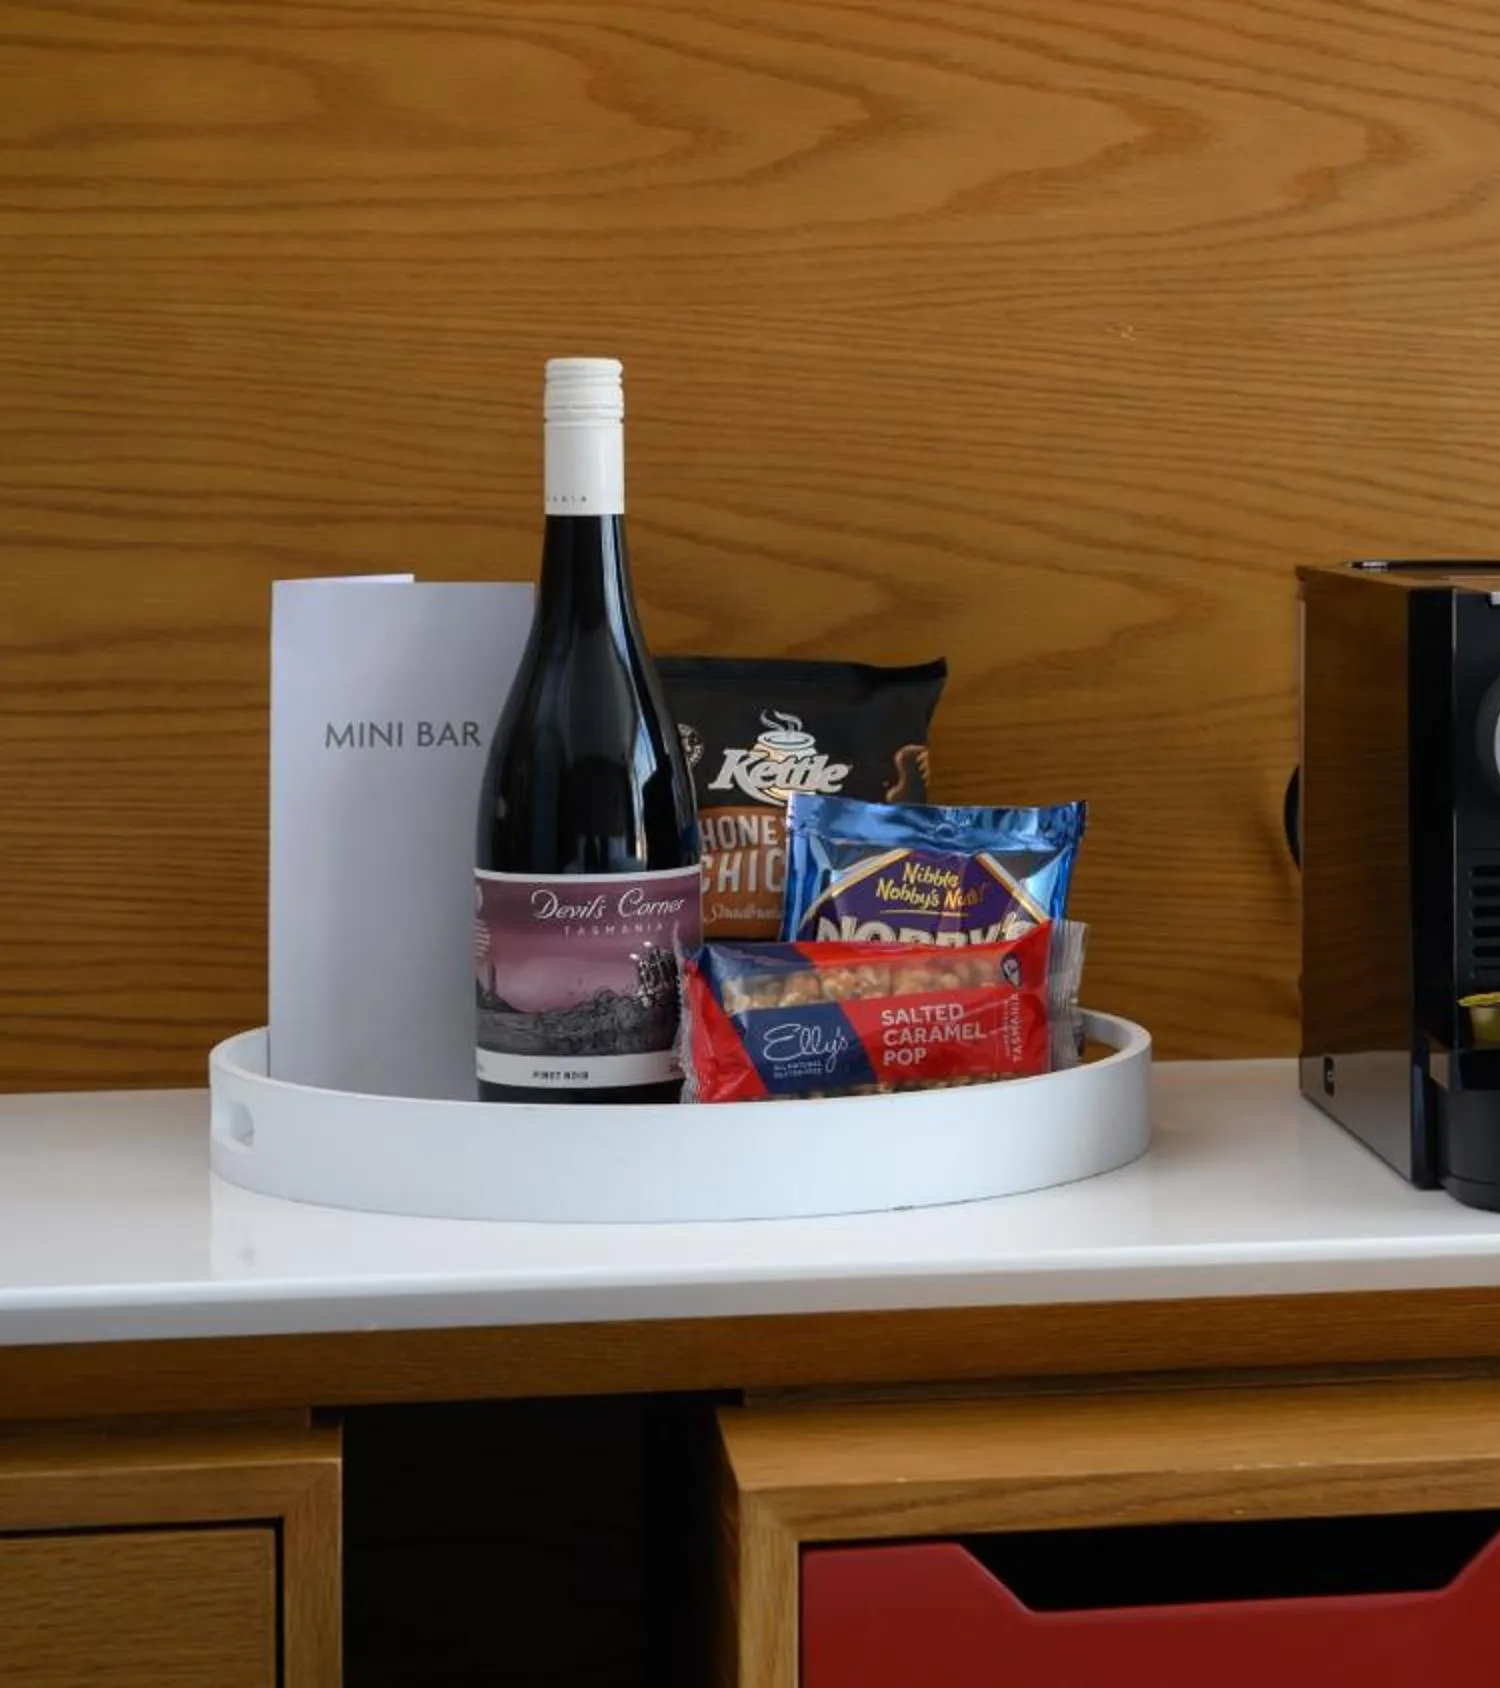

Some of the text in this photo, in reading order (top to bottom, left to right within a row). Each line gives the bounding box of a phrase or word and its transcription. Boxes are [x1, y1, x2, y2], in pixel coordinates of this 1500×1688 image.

[325, 721, 481, 749] MINI BAR
[708, 749, 852, 807] Kettle
[902, 862, 959, 886] Nibble
[531, 889, 607, 919] Devil's
[618, 887, 686, 918] Corner
[875, 878, 940, 909] Nobby's
[563, 922, 664, 937] TASMANIA
[881, 1003, 963, 1025] SALTED
[883, 1022, 988, 1046] CARAMEL
[763, 1023, 849, 1074] Elly's
[883, 1047, 928, 1066] POP
